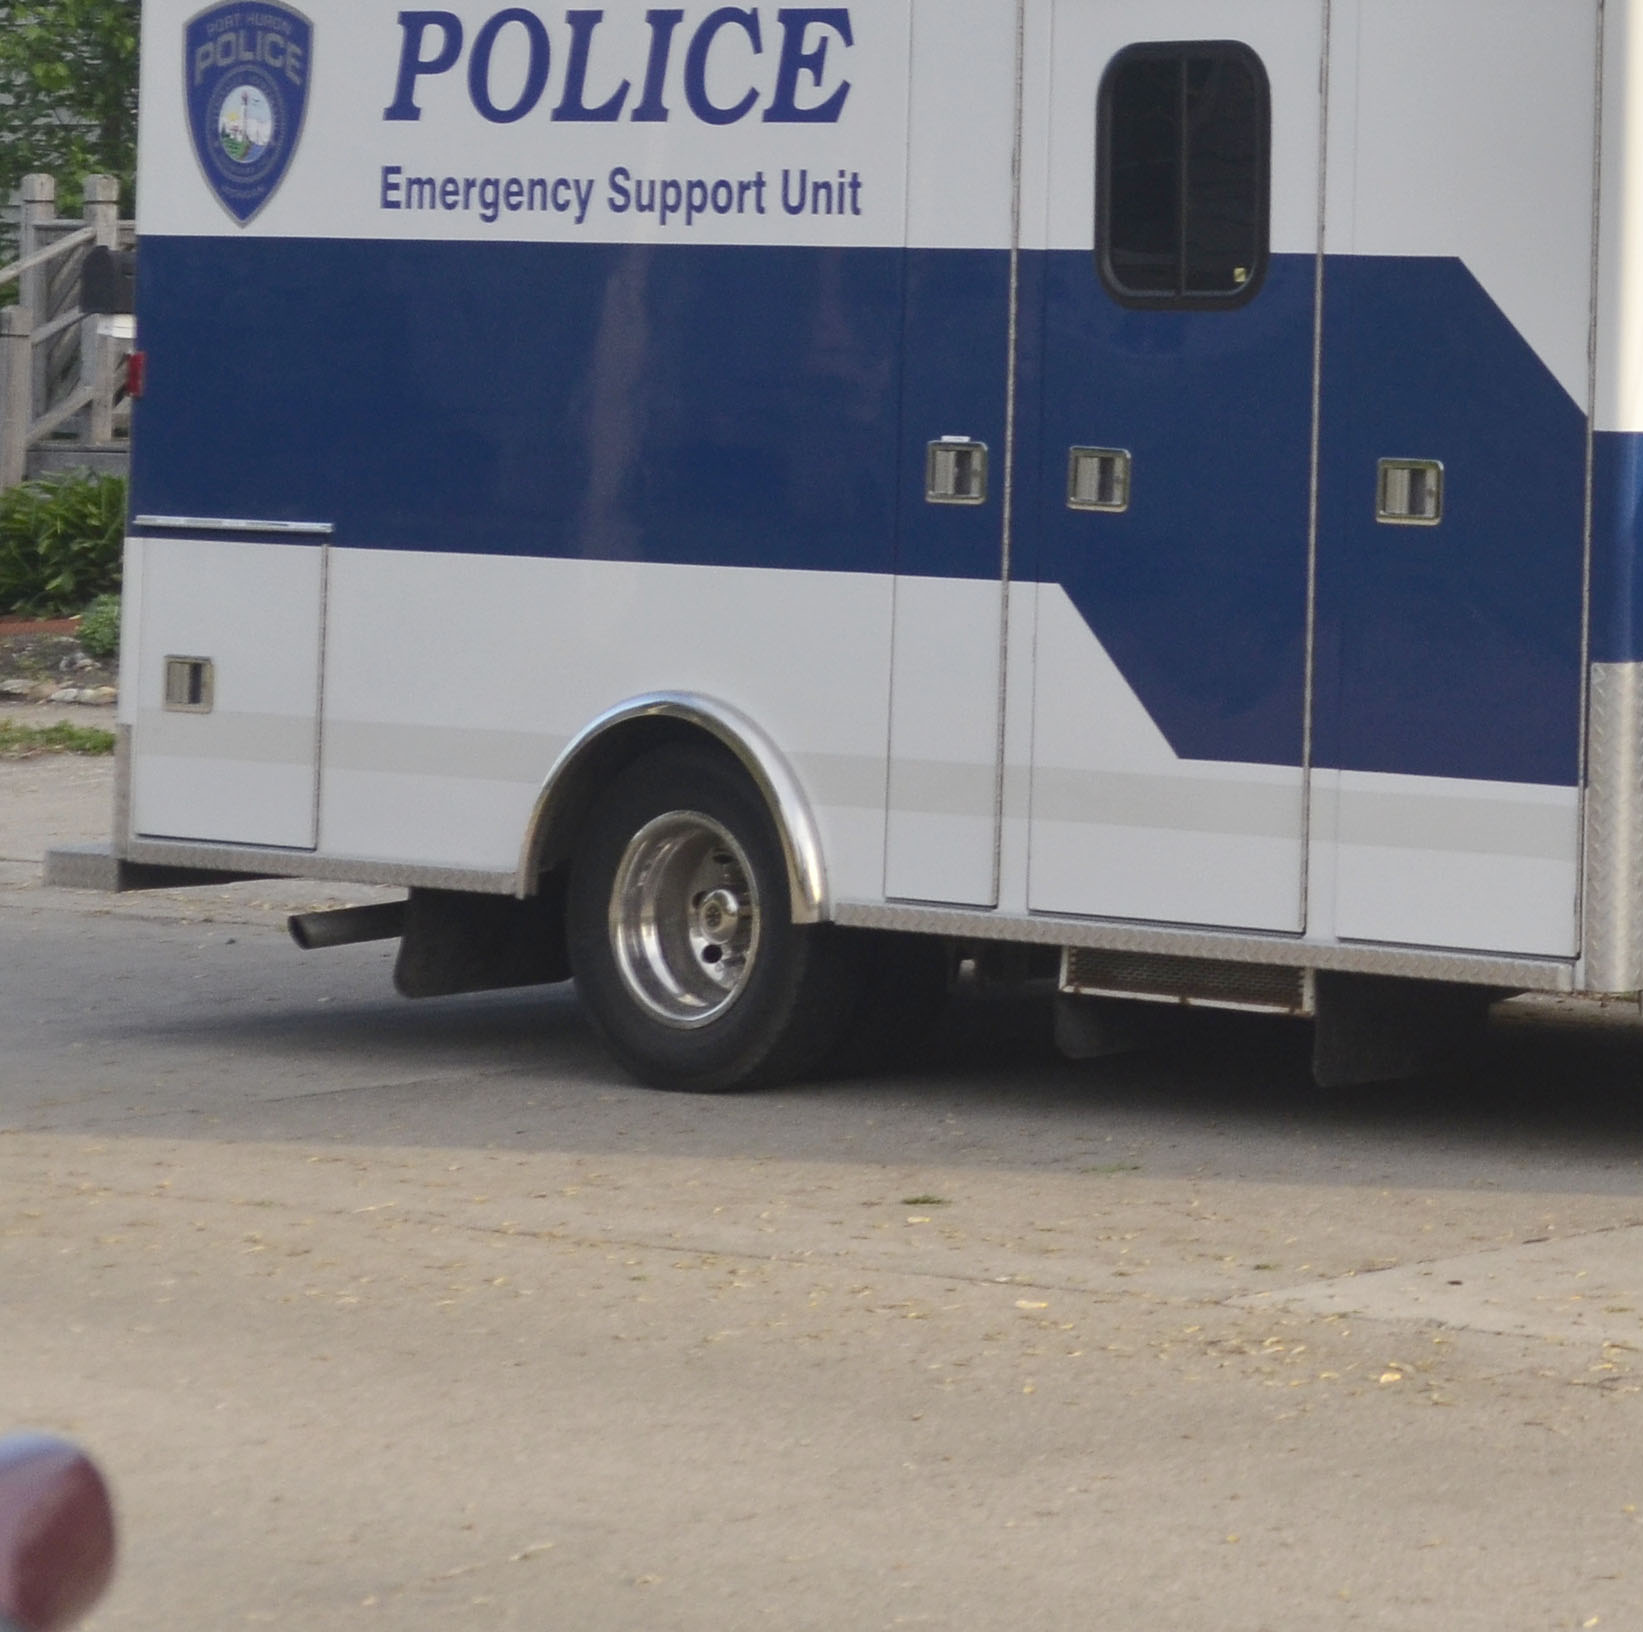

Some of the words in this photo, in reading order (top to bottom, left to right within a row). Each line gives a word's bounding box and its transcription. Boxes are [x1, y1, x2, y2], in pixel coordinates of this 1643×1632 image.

[195, 30, 303, 86] POLICE
[383, 7, 854, 125] POLICE
[381, 167, 592, 224] Emergency
[608, 167, 765, 225] Support
[781, 169, 862, 216] Unit
